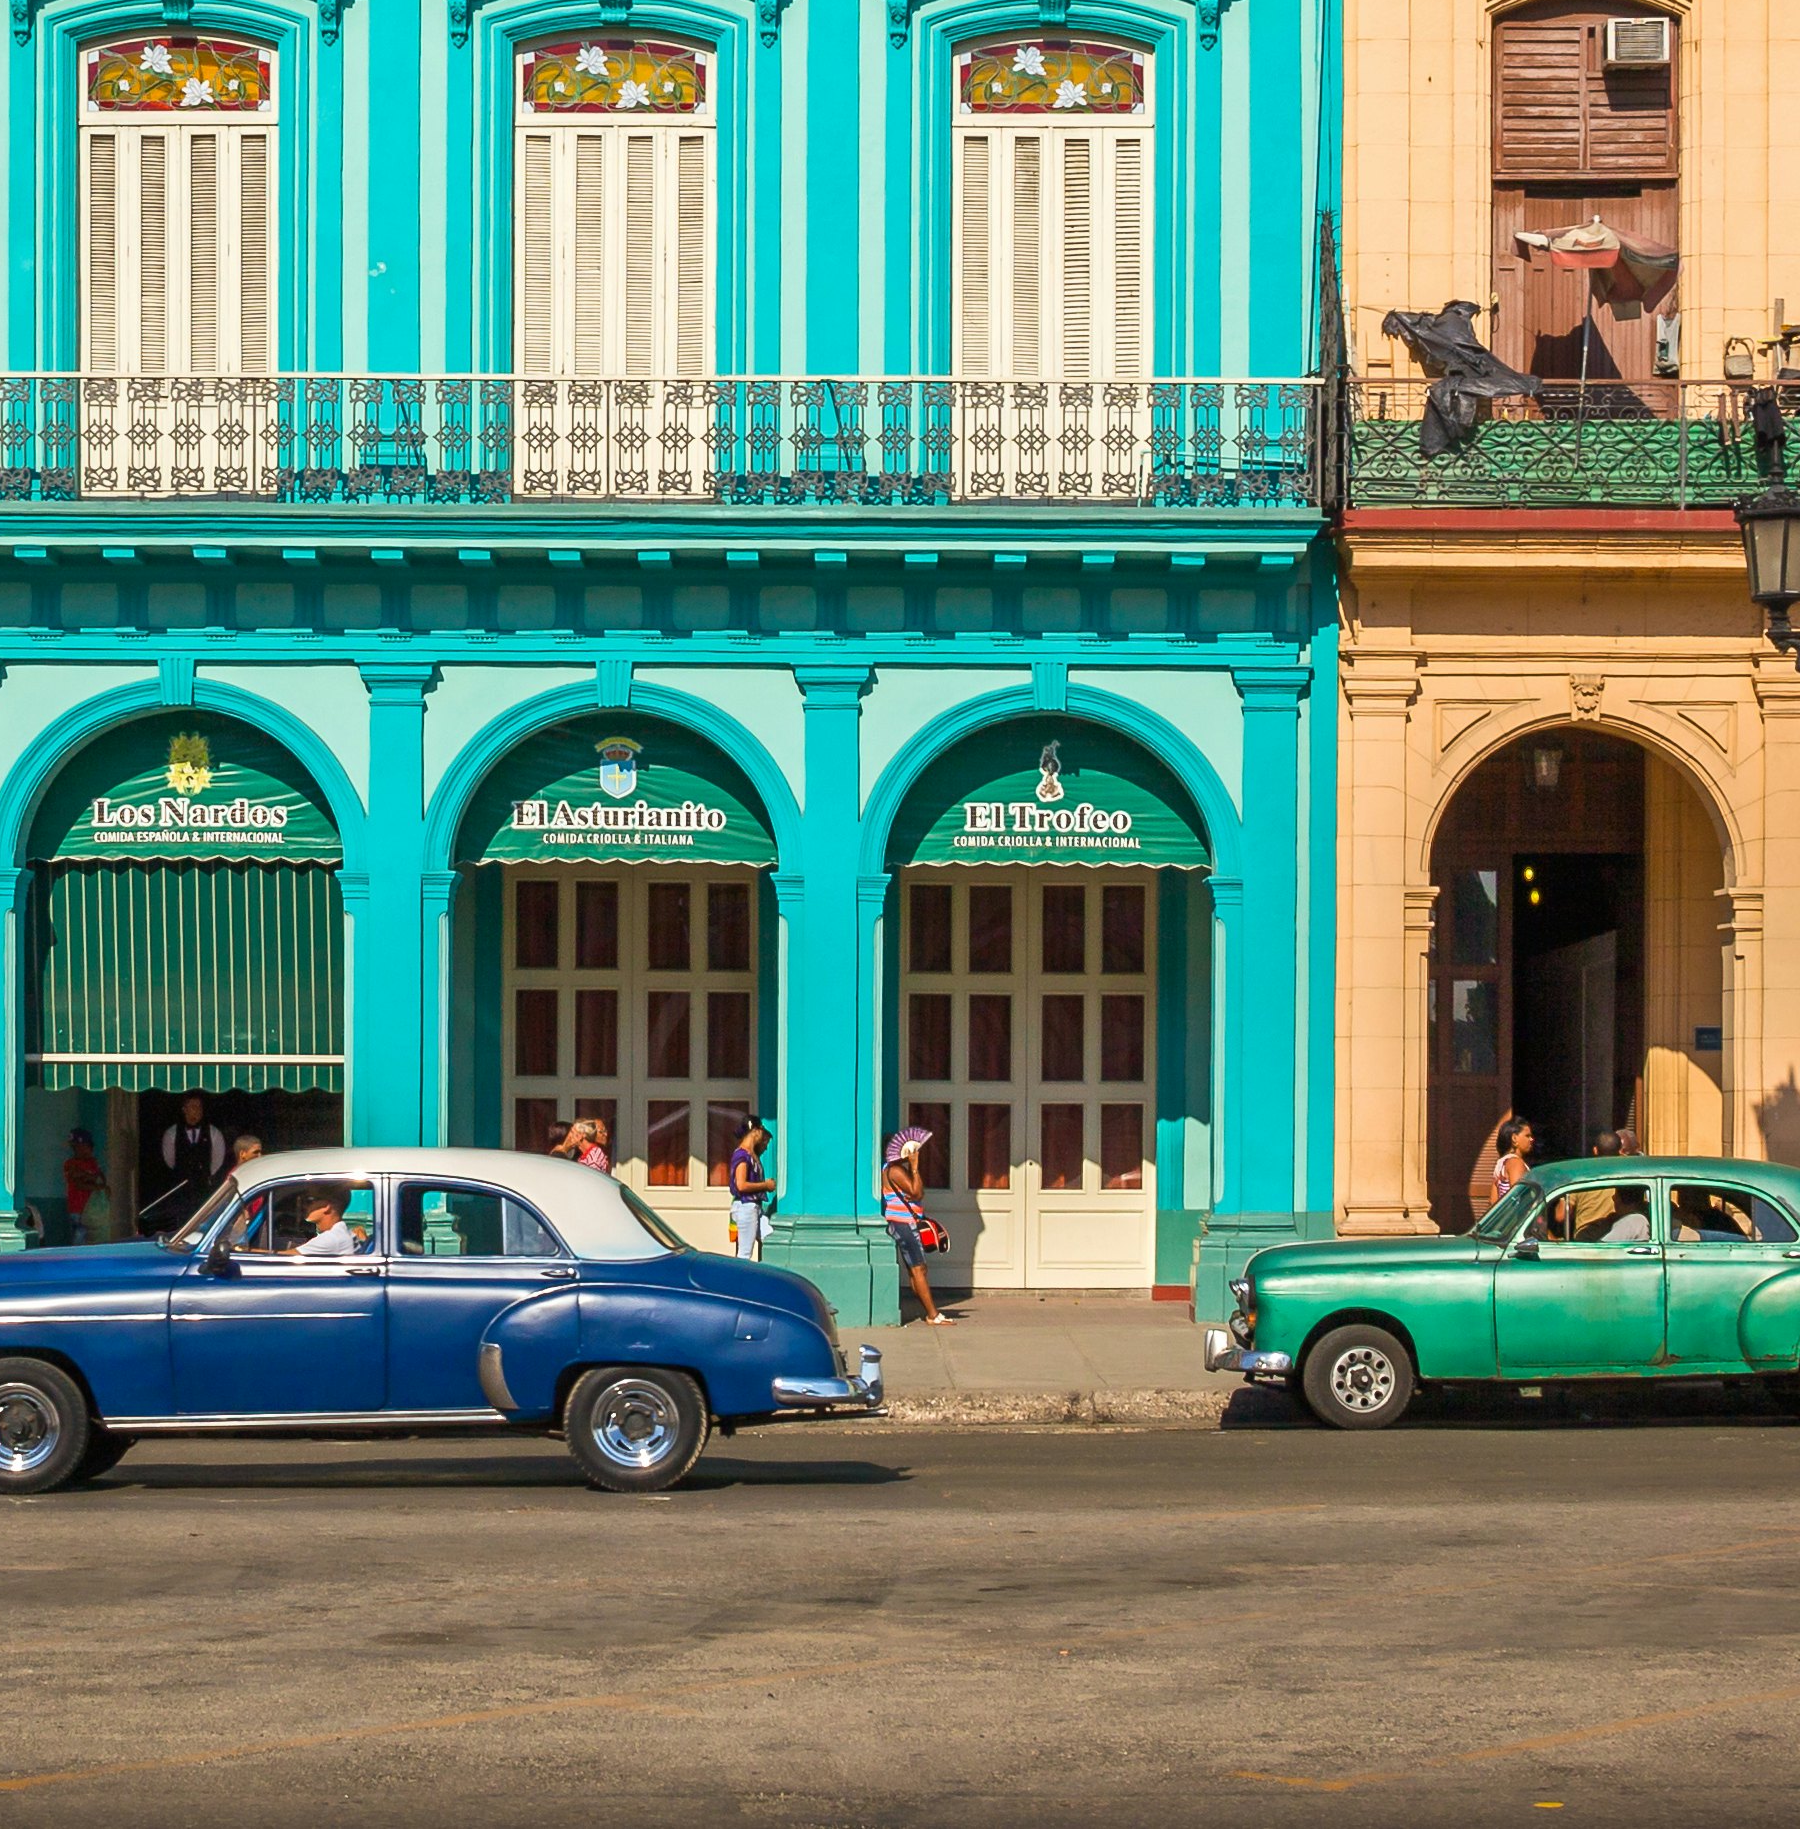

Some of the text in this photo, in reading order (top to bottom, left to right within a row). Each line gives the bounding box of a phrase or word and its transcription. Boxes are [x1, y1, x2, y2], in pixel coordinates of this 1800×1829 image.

[92, 799, 287, 827] Los Nardos
[512, 800, 726, 830] El Asturianito
[964, 803, 1131, 833] El Trofeo
[94, 830, 285, 843] COMIDA ESPAÑOLA & INTERNACIONAL
[543, 833, 694, 845] COMIDA CRIOLLA & ITALIANA
[954, 835, 1141, 849] COMIDA CRIOLLA & INTERNACIONAL
